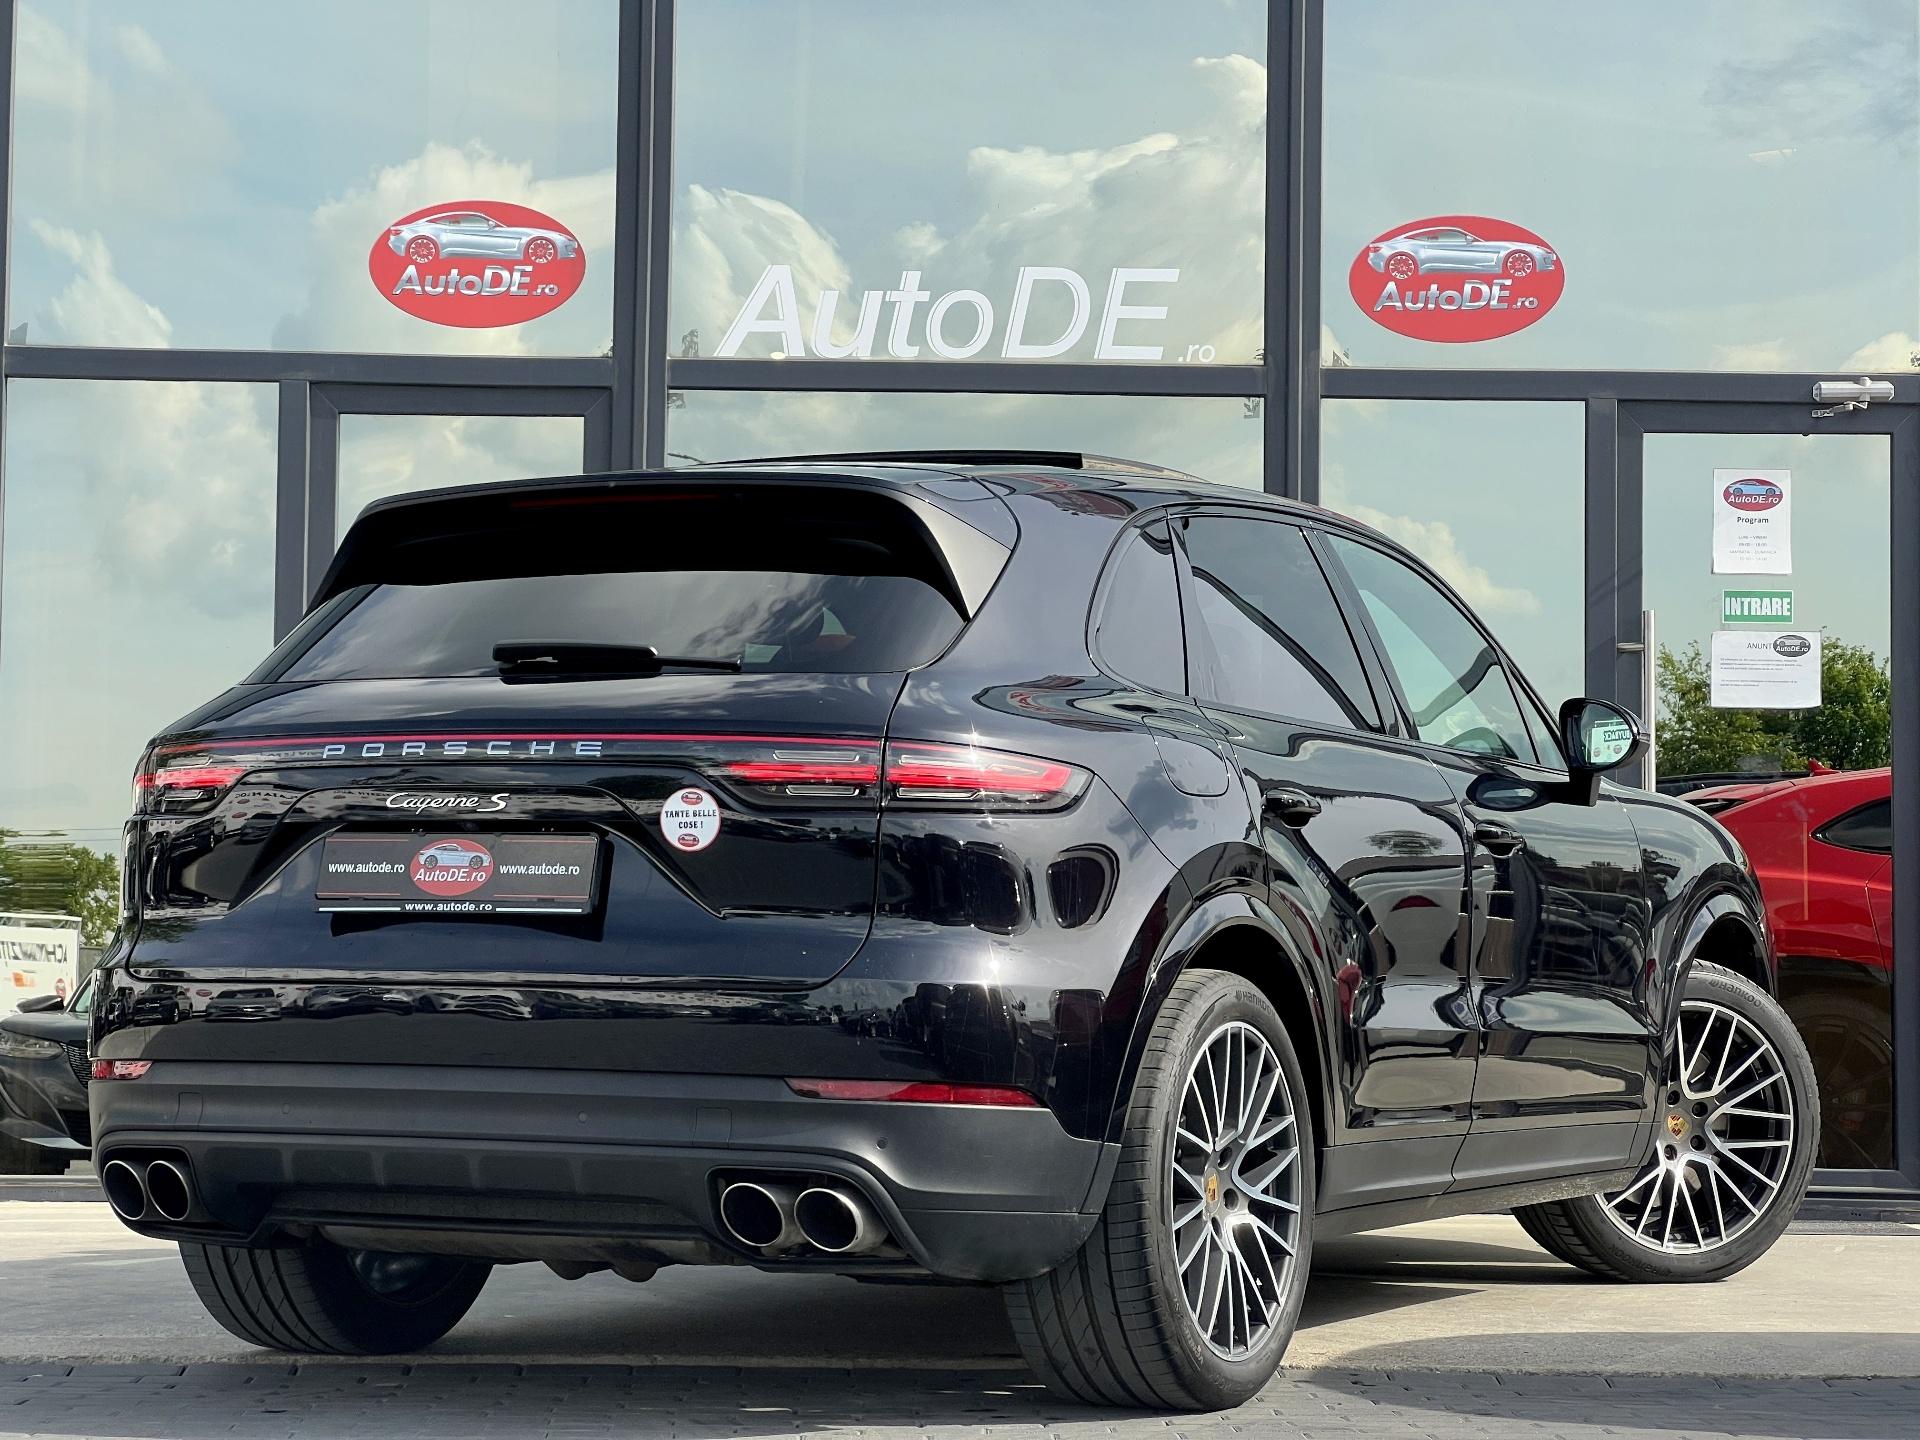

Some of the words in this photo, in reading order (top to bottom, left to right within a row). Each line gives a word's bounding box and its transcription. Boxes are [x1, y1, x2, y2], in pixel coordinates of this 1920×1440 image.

[1727, 495, 1780, 504] AutoDE.ro
[1736, 516, 1769, 525] Program
[1724, 597, 1791, 616] INTRARE
[1775, 644, 1809, 652] AutoDE.ro
[322, 741, 603, 758] PORSCHE
[385, 792, 480, 815] Cayenne
[476, 793, 511, 812] S
[665, 810, 690, 818] TANTE
[693, 809, 717, 817] BELLE
[678, 821, 699, 829] COSE
[328, 861, 405, 874] www.autode.ro
[499, 862, 580, 875] www.autode.ro
[413, 868, 486, 882] AutoDE.ro
[405, 901, 492, 912] www.autode.ro
